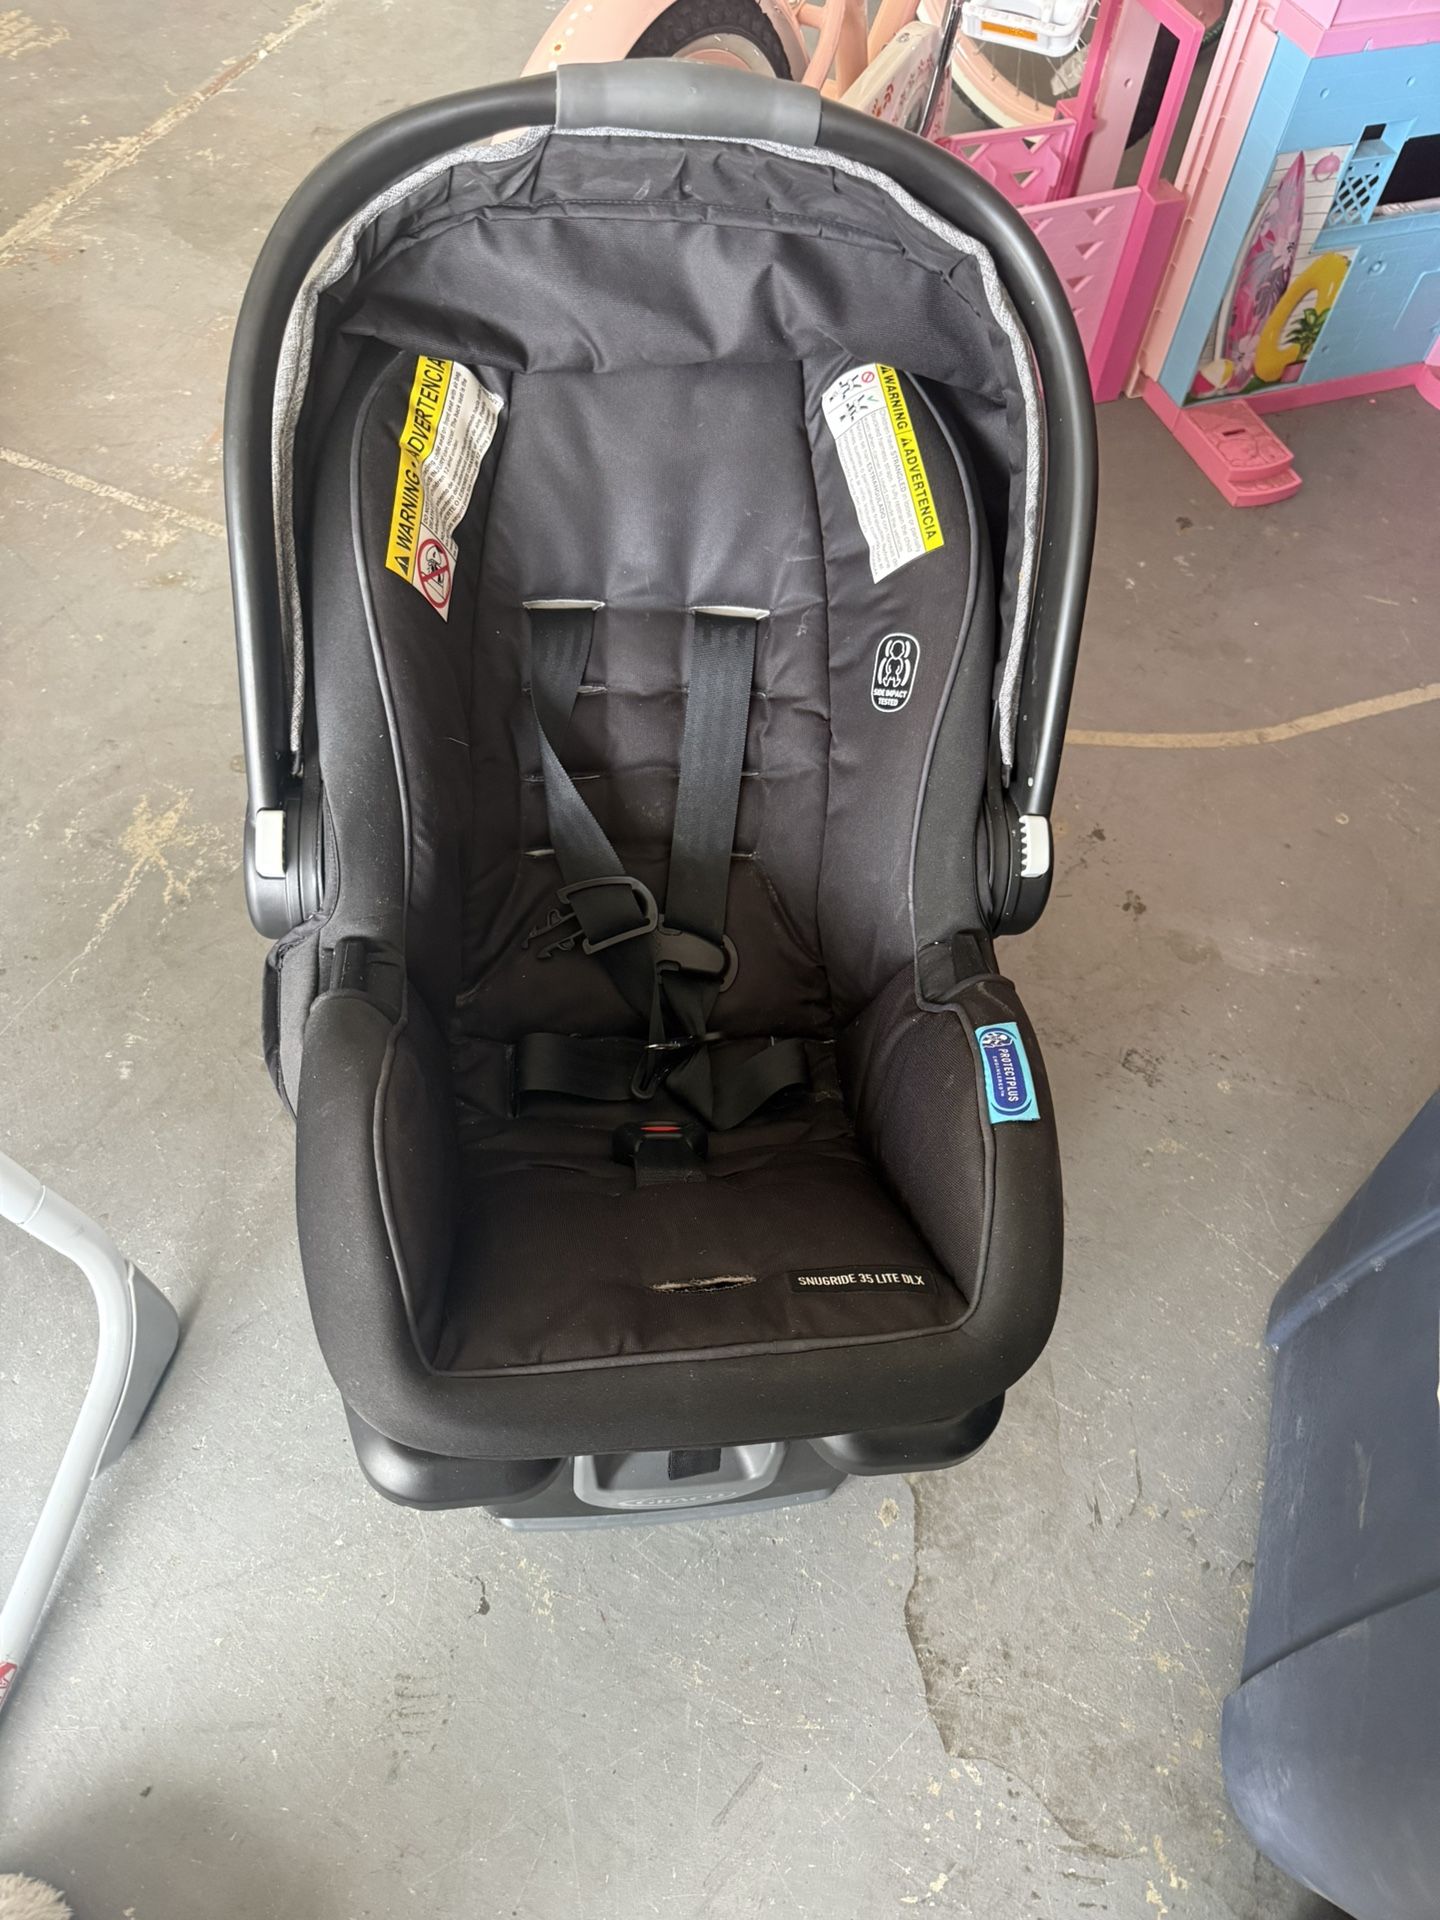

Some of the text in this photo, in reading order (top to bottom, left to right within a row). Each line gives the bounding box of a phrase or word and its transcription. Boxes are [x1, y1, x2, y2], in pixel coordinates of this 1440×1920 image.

[394, 468, 420, 551] WARNING
[408, 356, 446, 466] ADVERTENCIA
[882, 373, 937, 539] WARNING ADVERTENCIA
[890, 449, 907, 493] STRANGLED
[878, 697, 899, 706] TESTED
[998, 1048, 1020, 1102] PROTECTPLUS
[797, 1273, 926, 1286] SNUGRIDE 35 LITE DLX
